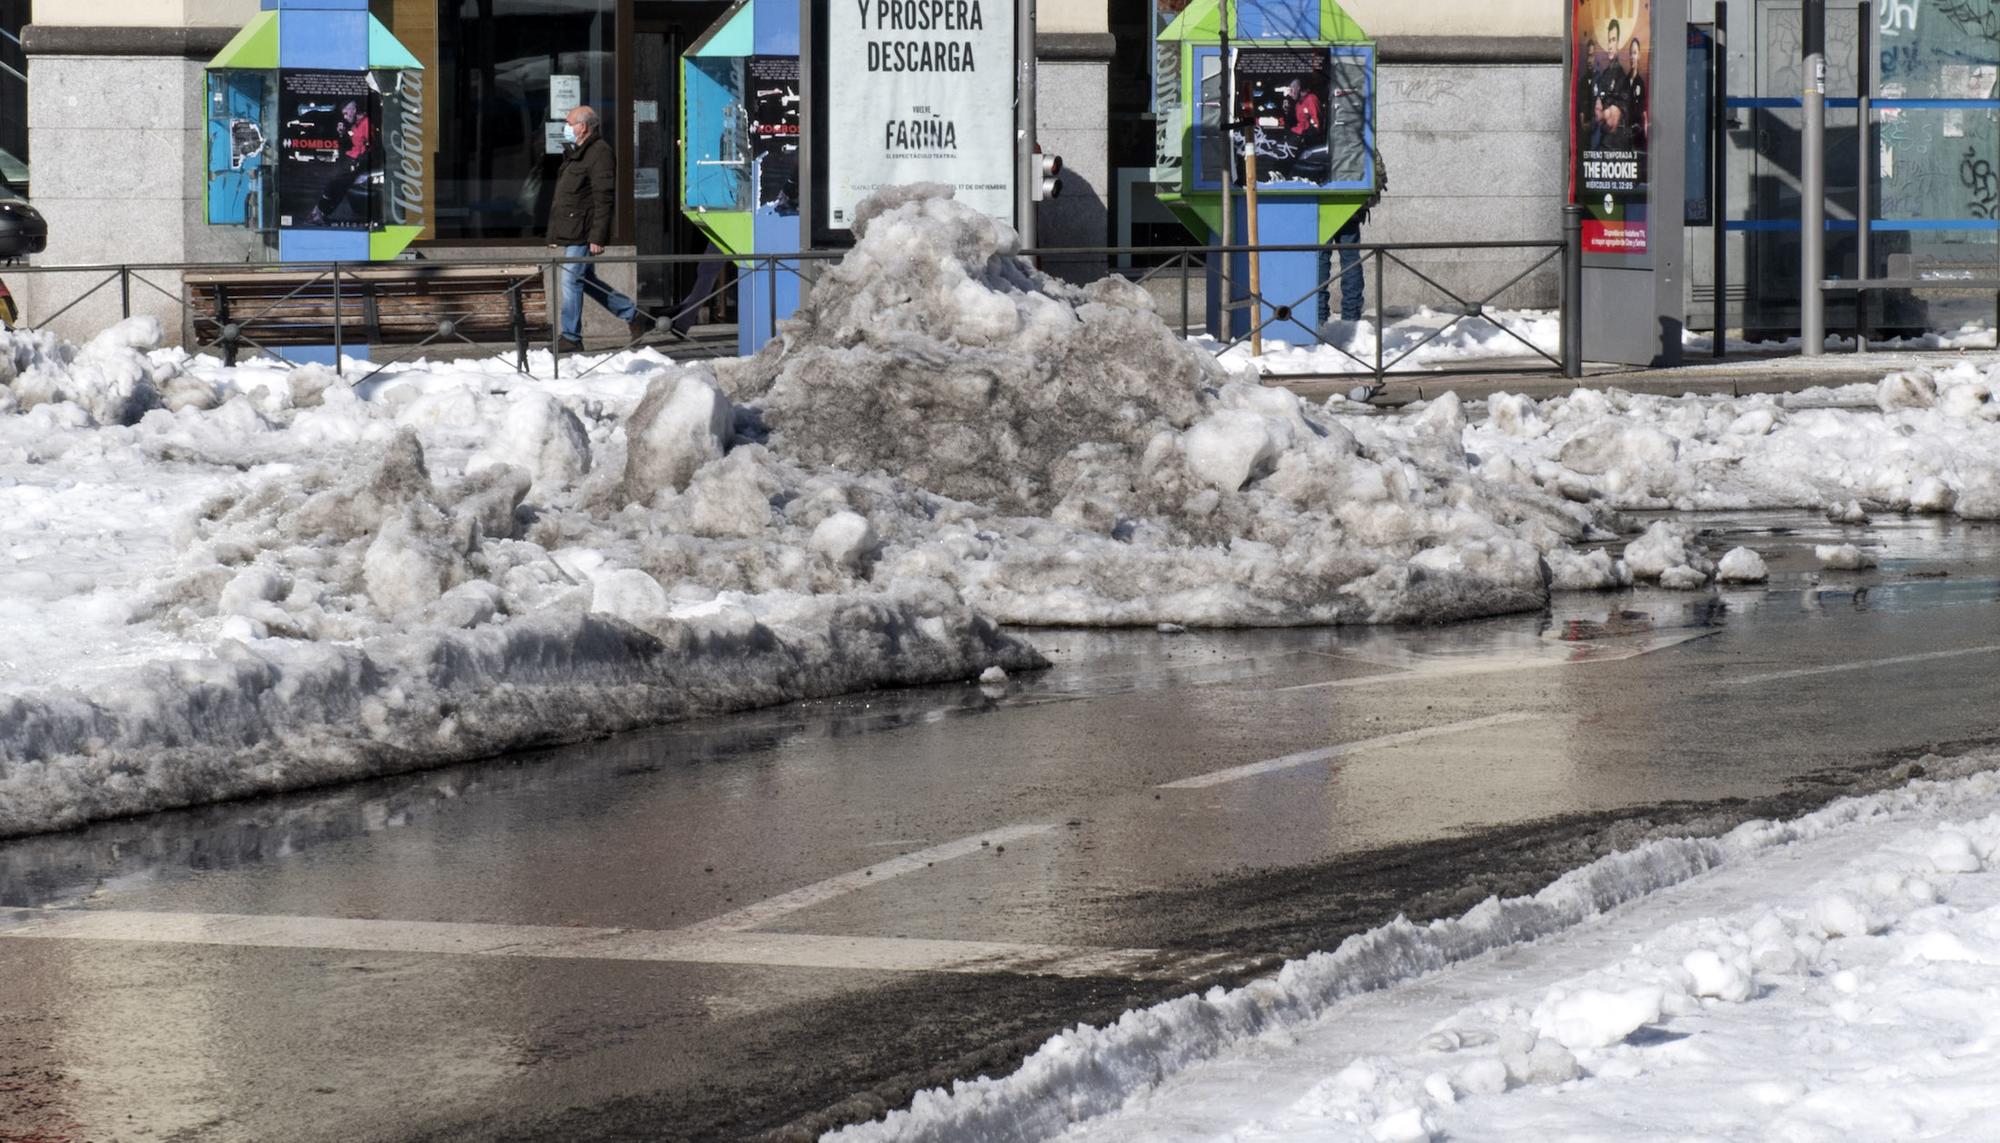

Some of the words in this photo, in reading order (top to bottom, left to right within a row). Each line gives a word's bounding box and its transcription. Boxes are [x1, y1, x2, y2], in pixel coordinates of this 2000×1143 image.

[858, 0, 870, 30] Y
[877, 0, 983, 31] PROSPERA
[867, 41, 975, 73] DESCARGA
[912, 105, 931, 114] VUELVE
[885, 114, 957, 150] FARIÑA
[1583, 150, 1602, 159] ESTRENO
[1603, 151, 1633, 159] TEMPORADA
[1583, 161, 1601, 178] THE
[1601, 162, 1638, 179] ROOKIE
